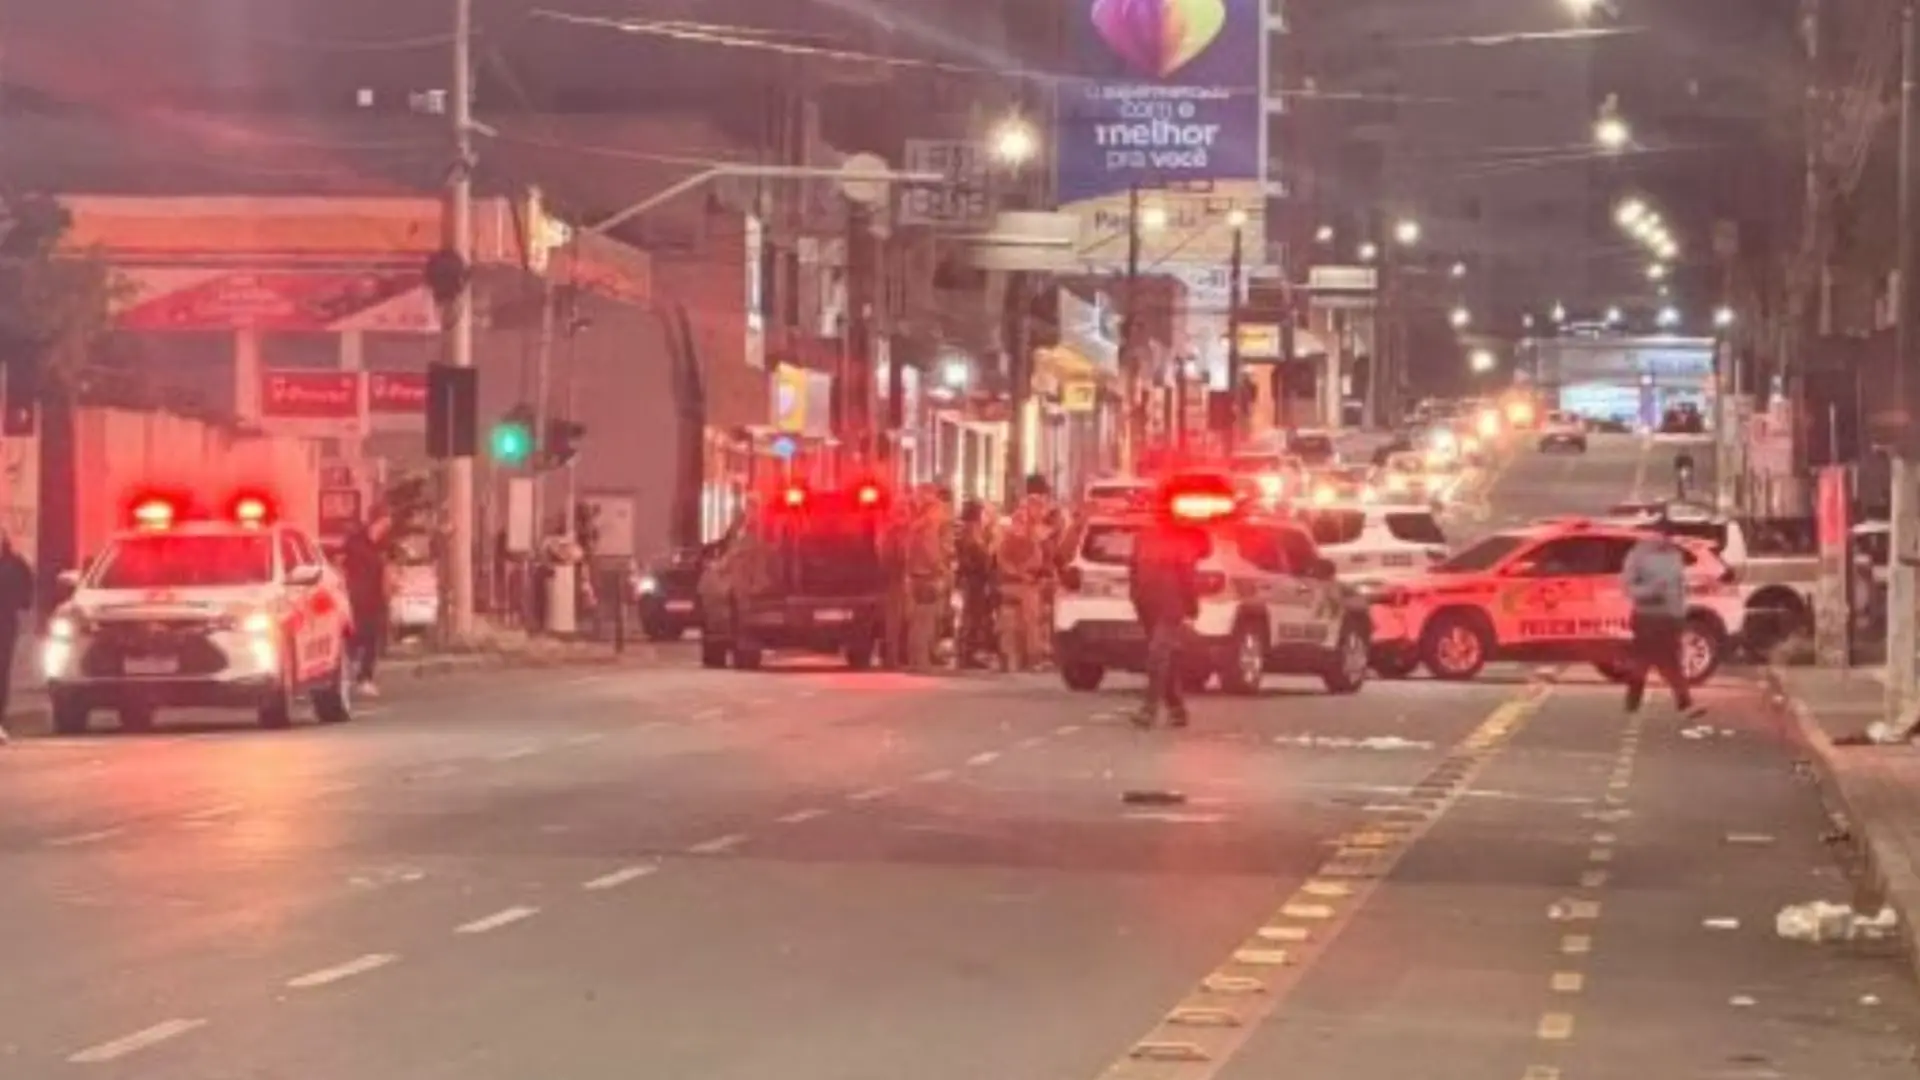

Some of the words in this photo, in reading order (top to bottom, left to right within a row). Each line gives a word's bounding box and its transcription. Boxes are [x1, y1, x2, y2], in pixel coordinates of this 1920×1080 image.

[1119, 101, 1172, 118] com
[1094, 119, 1220, 145] melhor
[1106, 151, 1146, 170] pra
[1149, 148, 1208, 168] você
